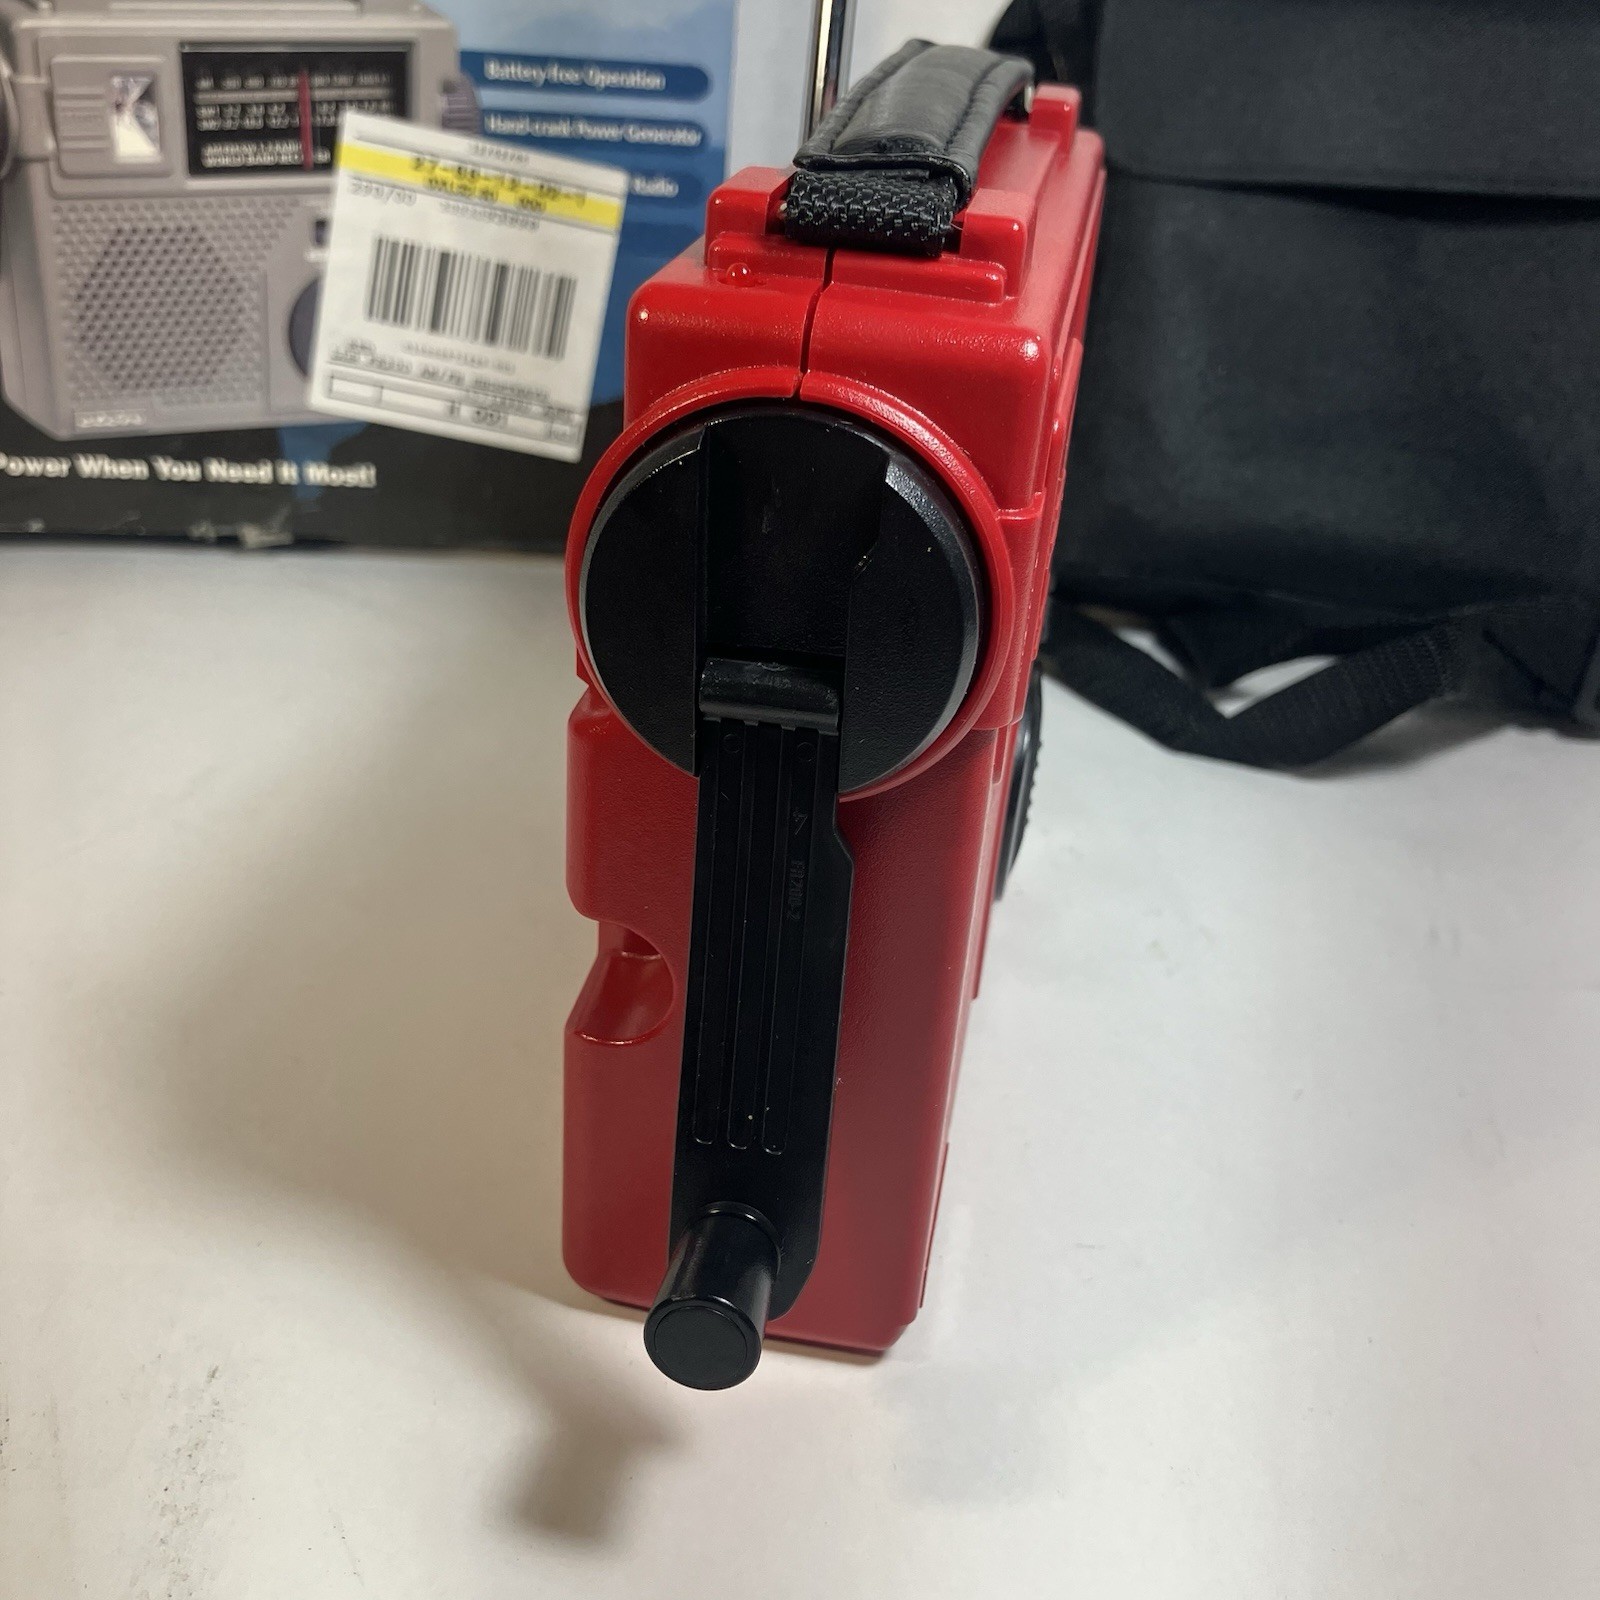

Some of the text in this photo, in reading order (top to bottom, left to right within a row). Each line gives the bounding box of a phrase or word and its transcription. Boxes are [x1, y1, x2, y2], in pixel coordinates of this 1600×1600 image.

[73, 453, 149, 481] When
[152, 456, 201, 482] You
[203, 457, 273, 484] Need
[275, 459, 298, 485] It
[302, 461, 377, 488] Most!
